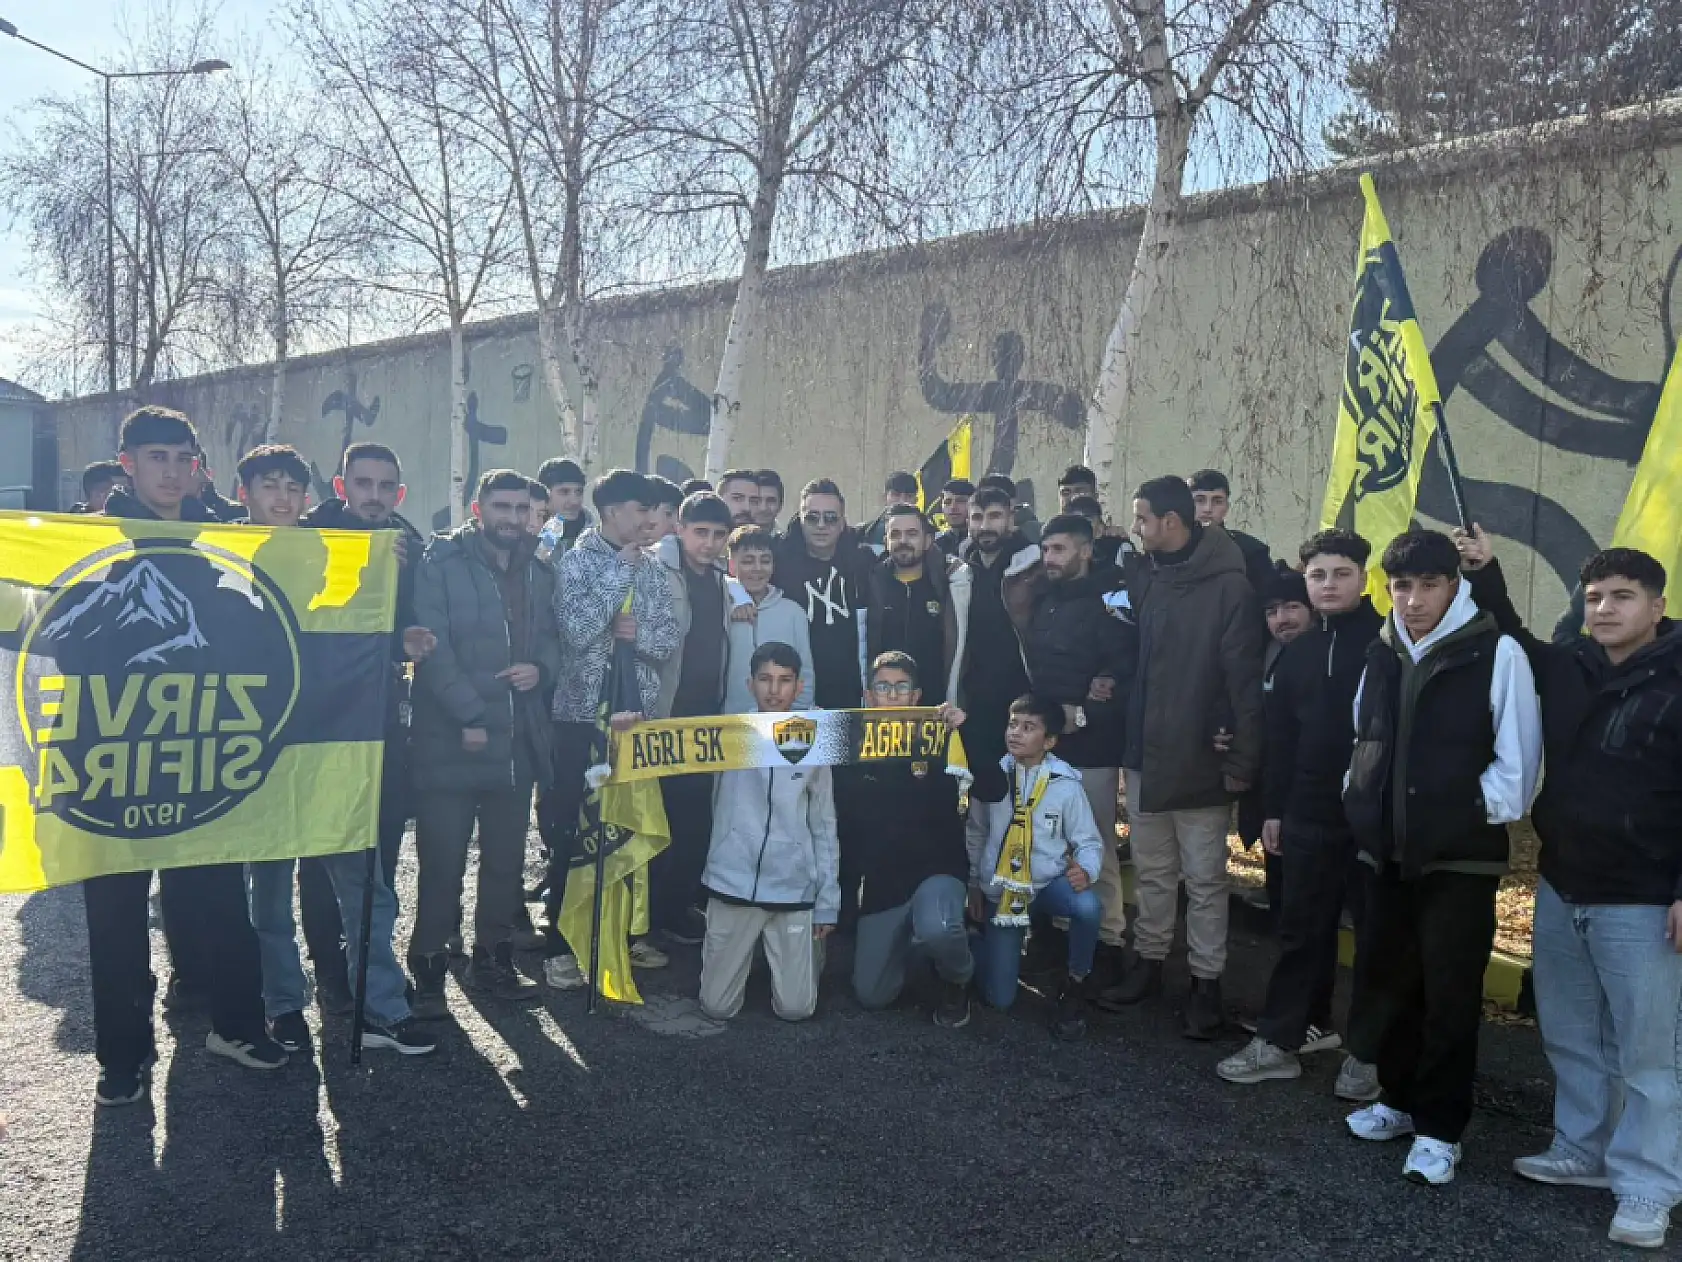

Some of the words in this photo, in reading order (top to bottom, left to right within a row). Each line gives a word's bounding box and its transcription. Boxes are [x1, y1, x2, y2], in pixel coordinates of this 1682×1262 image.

[804, 566, 850, 625] NY
[632, 729, 686, 770] AĞRI
[694, 727, 725, 763] SK
[860, 718, 915, 757] AĞRI
